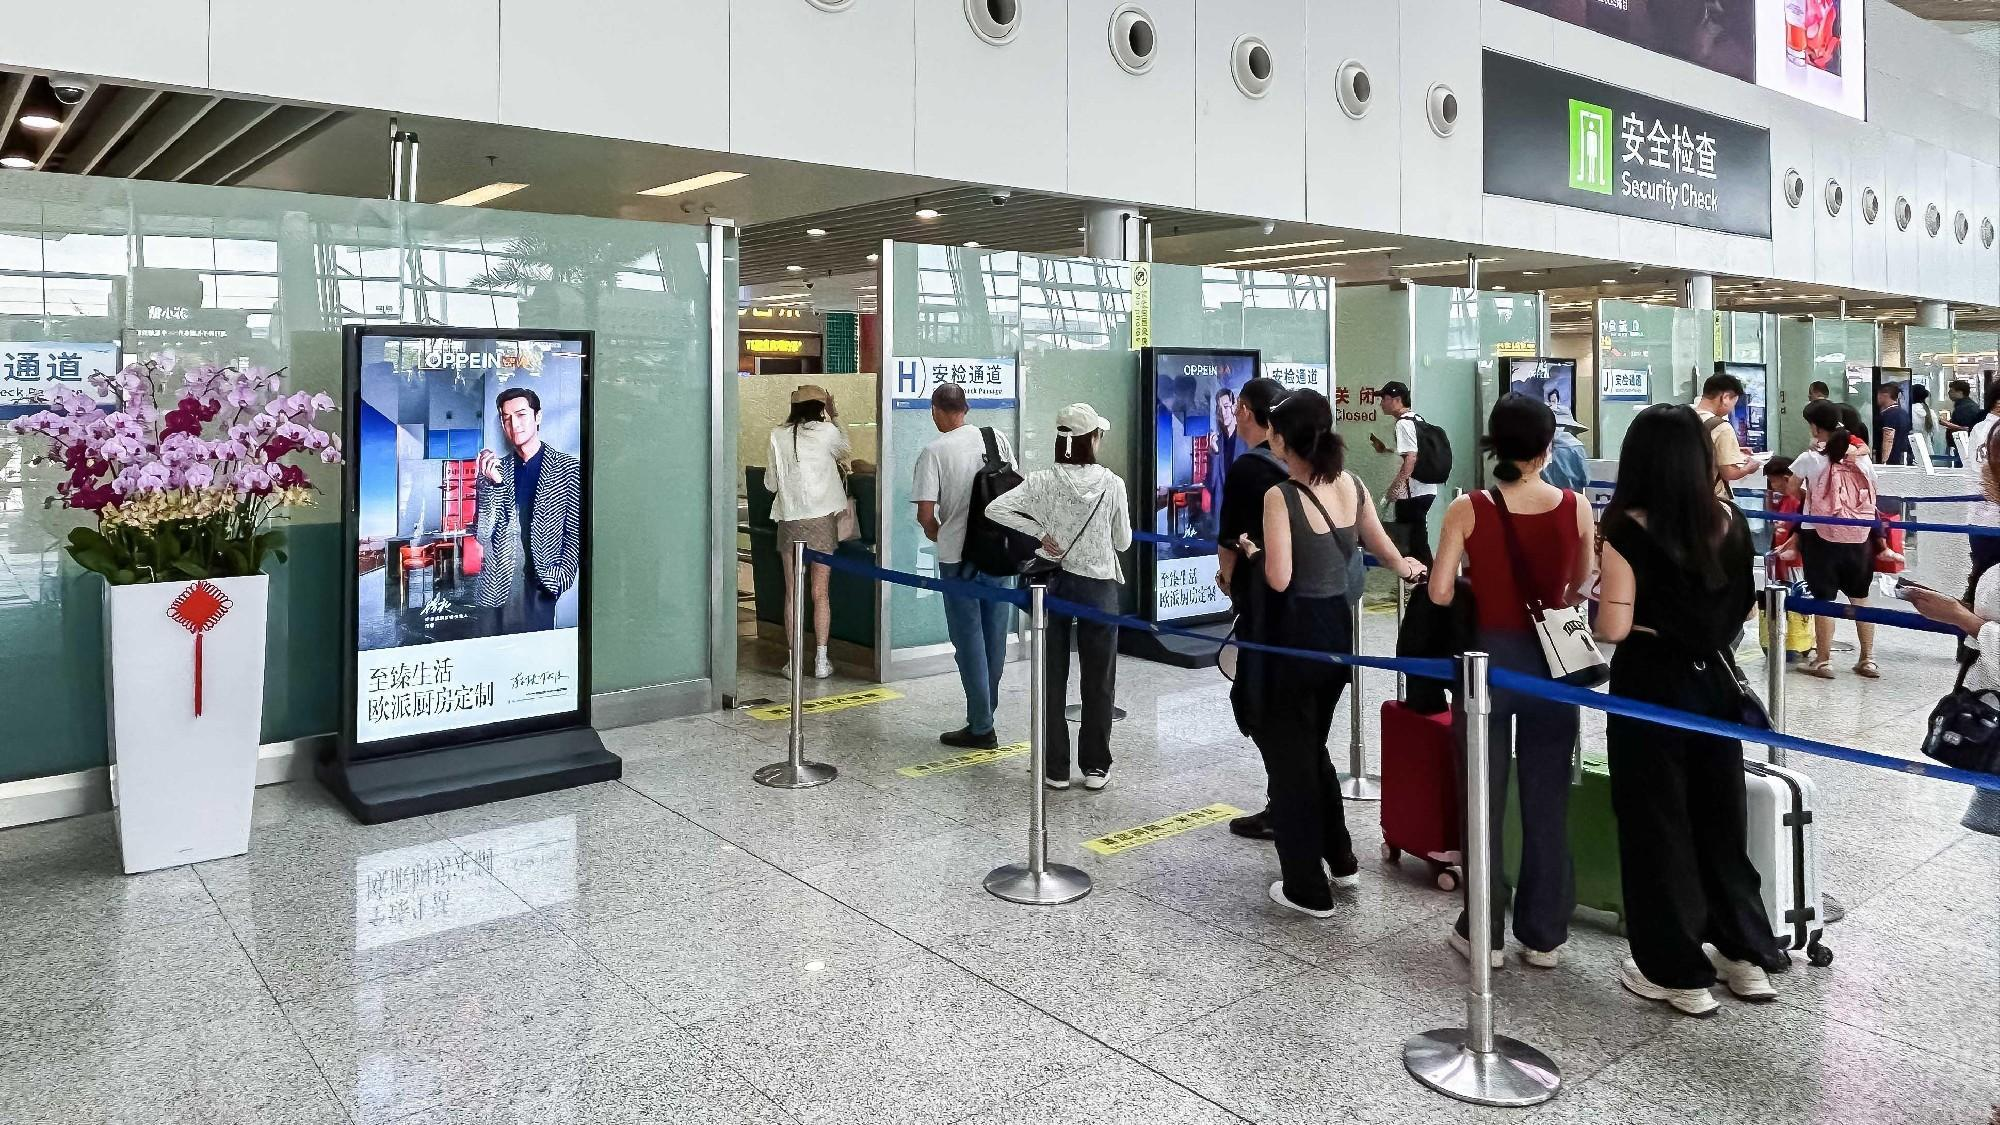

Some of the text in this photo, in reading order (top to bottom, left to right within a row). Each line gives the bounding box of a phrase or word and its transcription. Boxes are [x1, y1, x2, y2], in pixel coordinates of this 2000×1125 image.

[1621, 112, 1718, 180] 安全检查
[1621, 170, 1719, 212] Security Check
[3, 352, 82, 381] 通道
[425, 352, 500, 369] OPPEIN
[932, 364, 1002, 384] 安检通道
[1183, 364, 1218, 376] OPPEIN
[898, 360, 916, 392] H
[1272, 368, 1318, 385] 安检通道
[1336, 408, 1376, 421] Closed
[369, 657, 453, 693] 至臻生活
[368, 681, 494, 724] 欧派厨房定制
